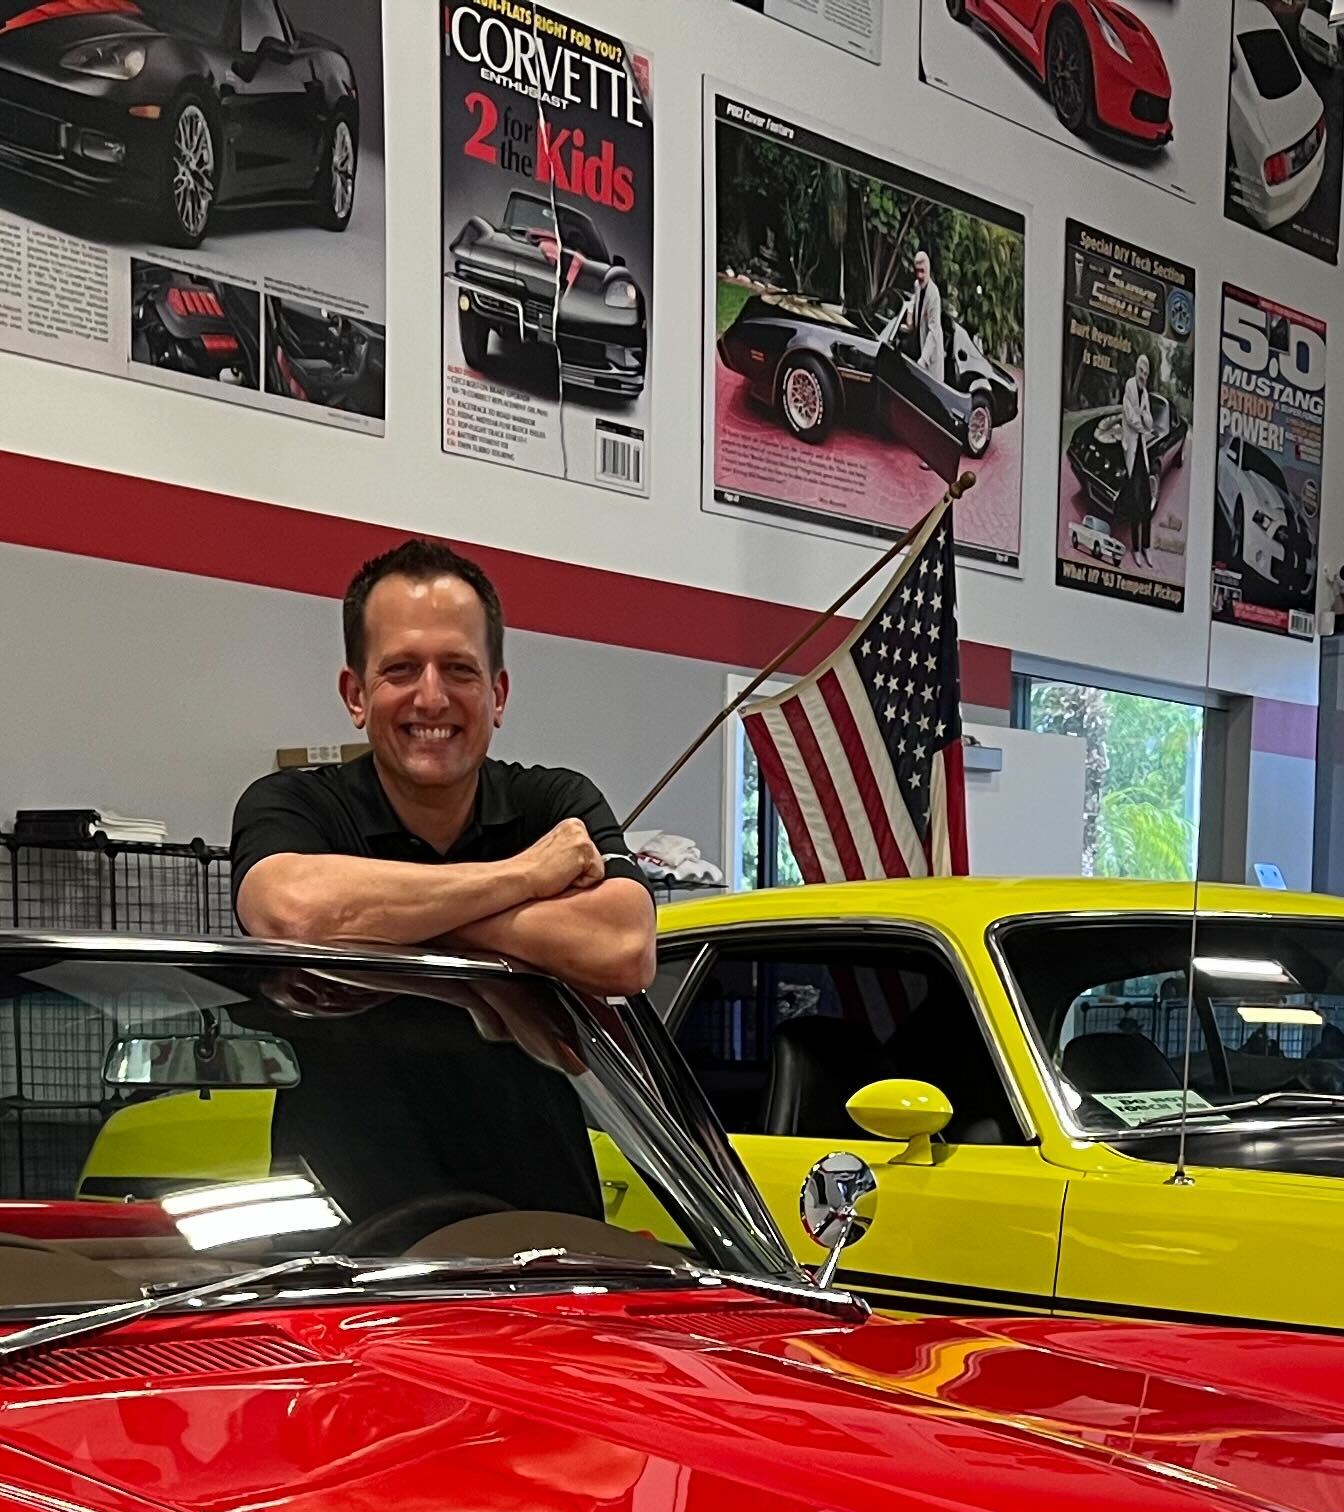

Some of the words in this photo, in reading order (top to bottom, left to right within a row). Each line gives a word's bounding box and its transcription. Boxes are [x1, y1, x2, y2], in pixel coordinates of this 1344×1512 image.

[533, 13, 568, 41] RIGHT
[570, 28, 592, 50] FOR
[594, 37, 623, 63] YOU?
[451, 6, 644, 128] CORVETTE
[480, 67, 569, 110] ENTHUSAST
[463, 91, 499, 165] 2
[503, 106, 533, 143] for
[500, 140, 533, 177] the
[534, 117, 635, 213] Kids
[1079, 231, 1113, 257] Special
[1131, 251, 1152, 273] Tech
[1153, 260, 1186, 286] Section
[1221, 296, 1327, 392] 5.0
[1220, 383, 1274, 422] PATRIOT
[1222, 364, 1324, 416] MUSTANG
[1219, 405, 1285, 453] POWER!
[1062, 561, 1087, 581] What
[1116, 574, 1153, 596] Tempest
[1153, 582, 1182, 605] Pickup
